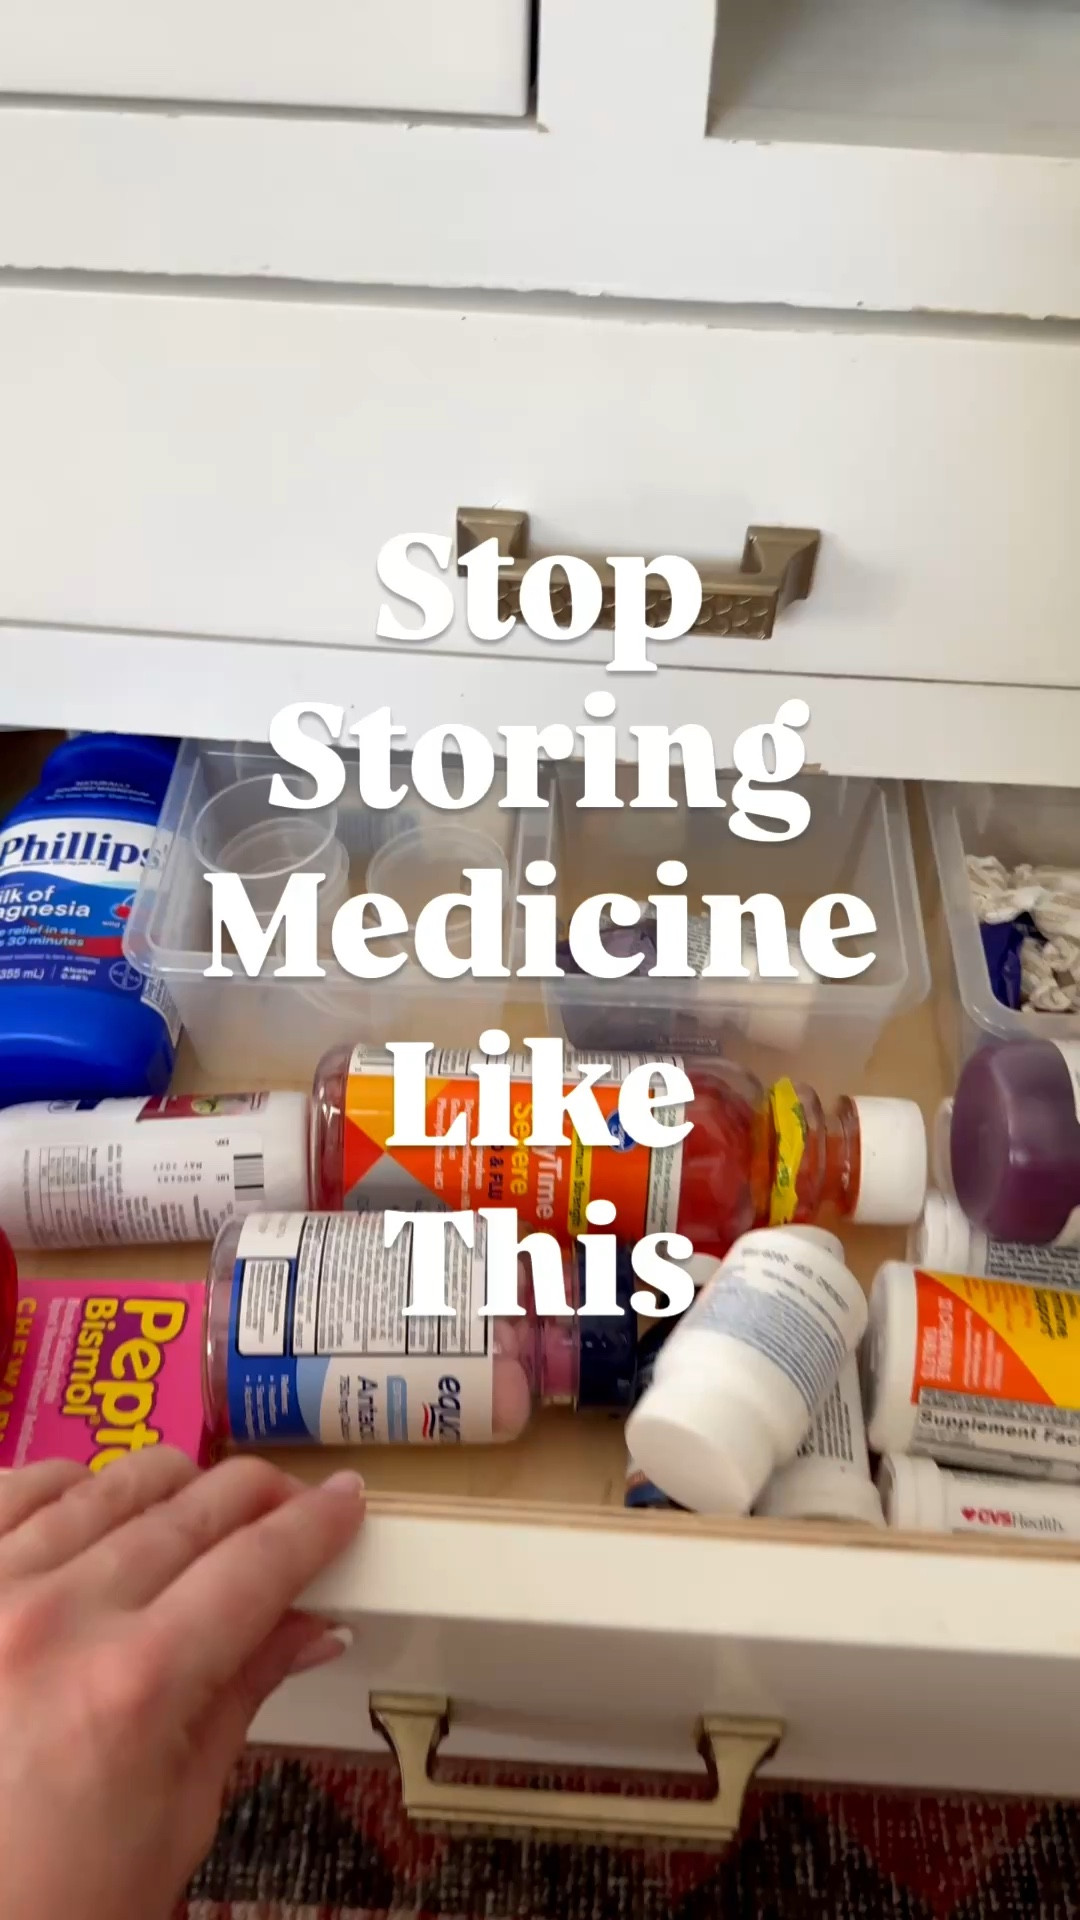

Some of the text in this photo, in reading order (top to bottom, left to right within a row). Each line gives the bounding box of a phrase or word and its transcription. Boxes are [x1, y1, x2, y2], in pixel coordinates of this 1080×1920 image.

[0, 888, 22, 904] ilk
[27, 885, 56, 902] of
[0, 901, 90, 922] agnesia
[9, 924, 42, 937] relief
[7, 937, 27, 947] 30
[28, 936, 84, 947] minutes
[533, 1145, 563, 1220] yTime
[62, 1297, 120, 1417] Bismol
[919, 1410, 1080, 1448] Supplement Fac
